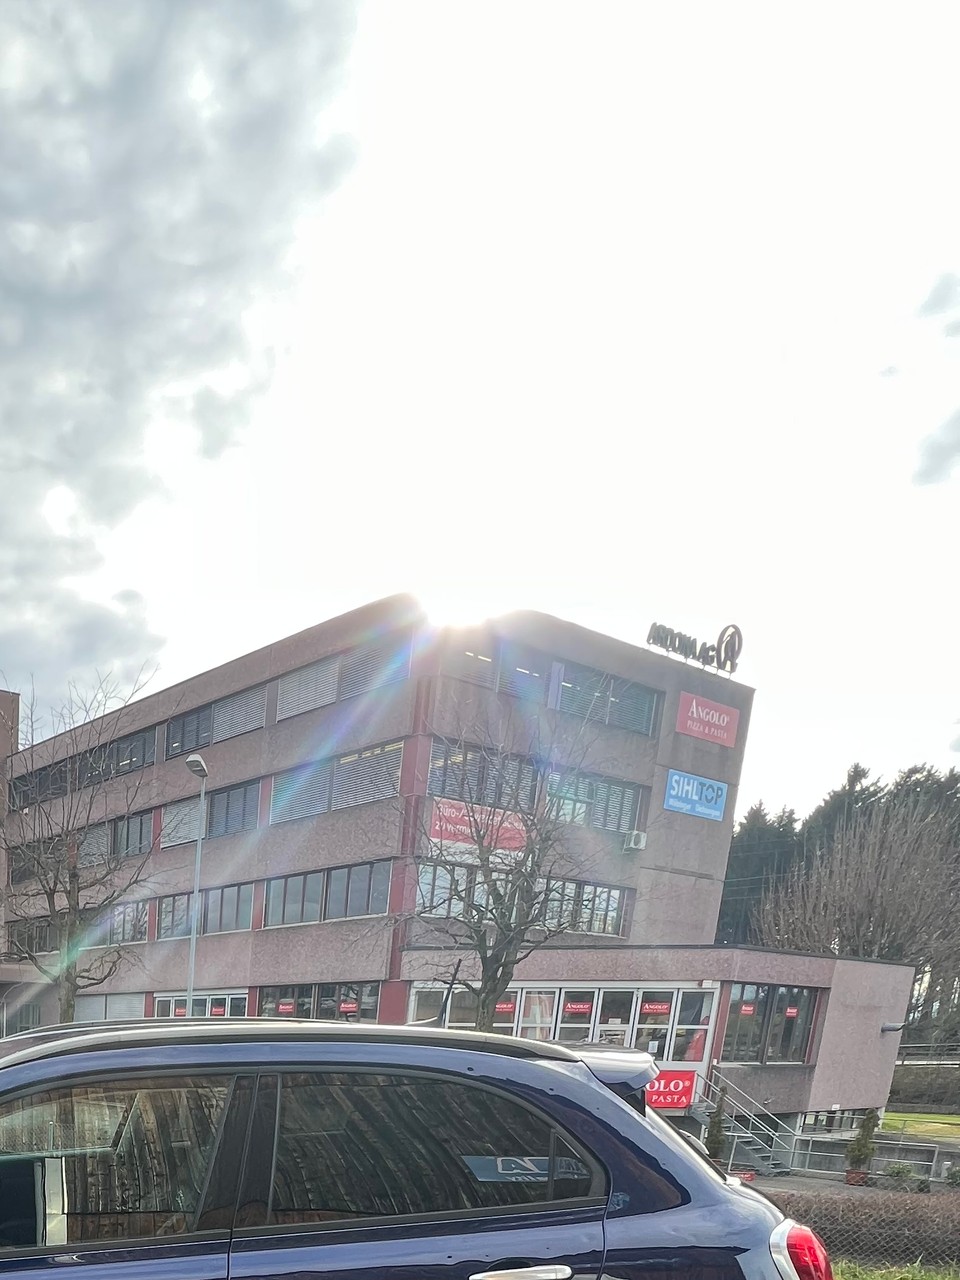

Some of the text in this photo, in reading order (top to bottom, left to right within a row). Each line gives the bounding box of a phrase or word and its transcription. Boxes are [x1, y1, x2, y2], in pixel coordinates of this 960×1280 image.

[688, 698, 728, 727] ANGOLO
[710, 727, 727, 739] PASTA
[671, 774, 724, 805] SIHLTOP
[651, 1094, 686, 1103] PASTA
